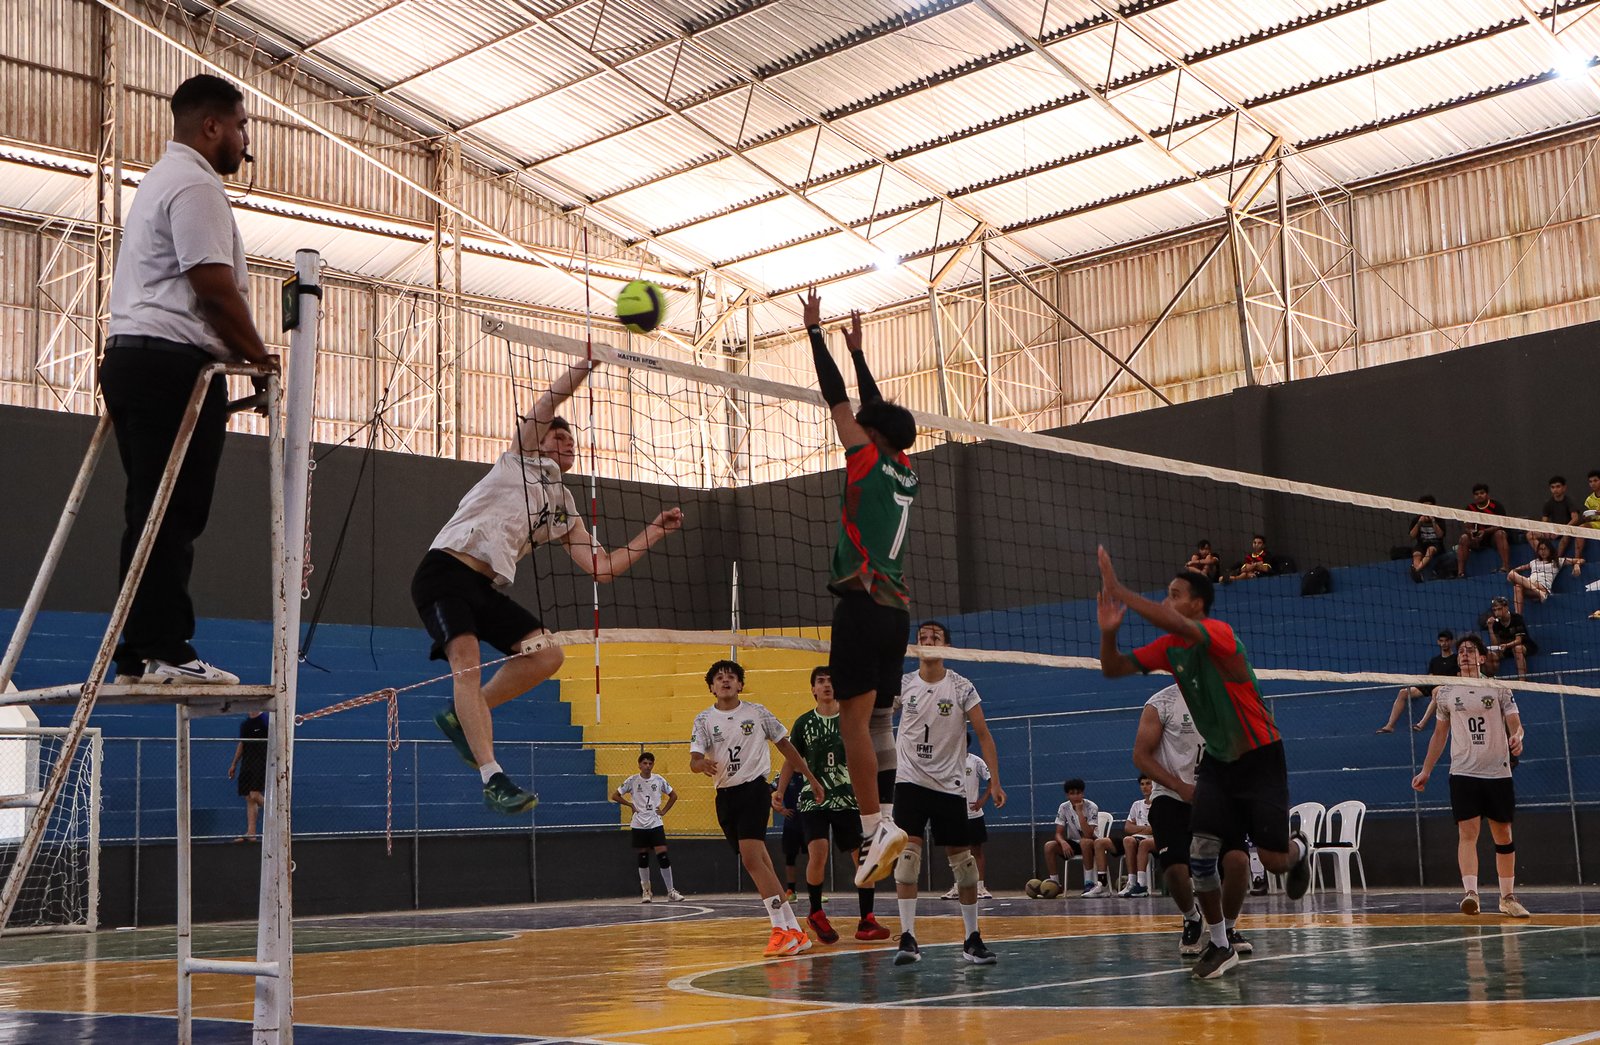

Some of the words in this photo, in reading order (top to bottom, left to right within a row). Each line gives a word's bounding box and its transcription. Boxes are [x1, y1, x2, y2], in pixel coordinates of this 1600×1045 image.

[617, 352, 641, 363] MASTER
[888, 491, 914, 560] 7
[1467, 716, 1486, 732] 02
[924, 723, 930, 743] 1
[1471, 733, 1485, 741] IFMT
[727, 745, 741, 762] 12
[916, 744, 934, 753] IFMT
[827, 752, 835, 767] 8
